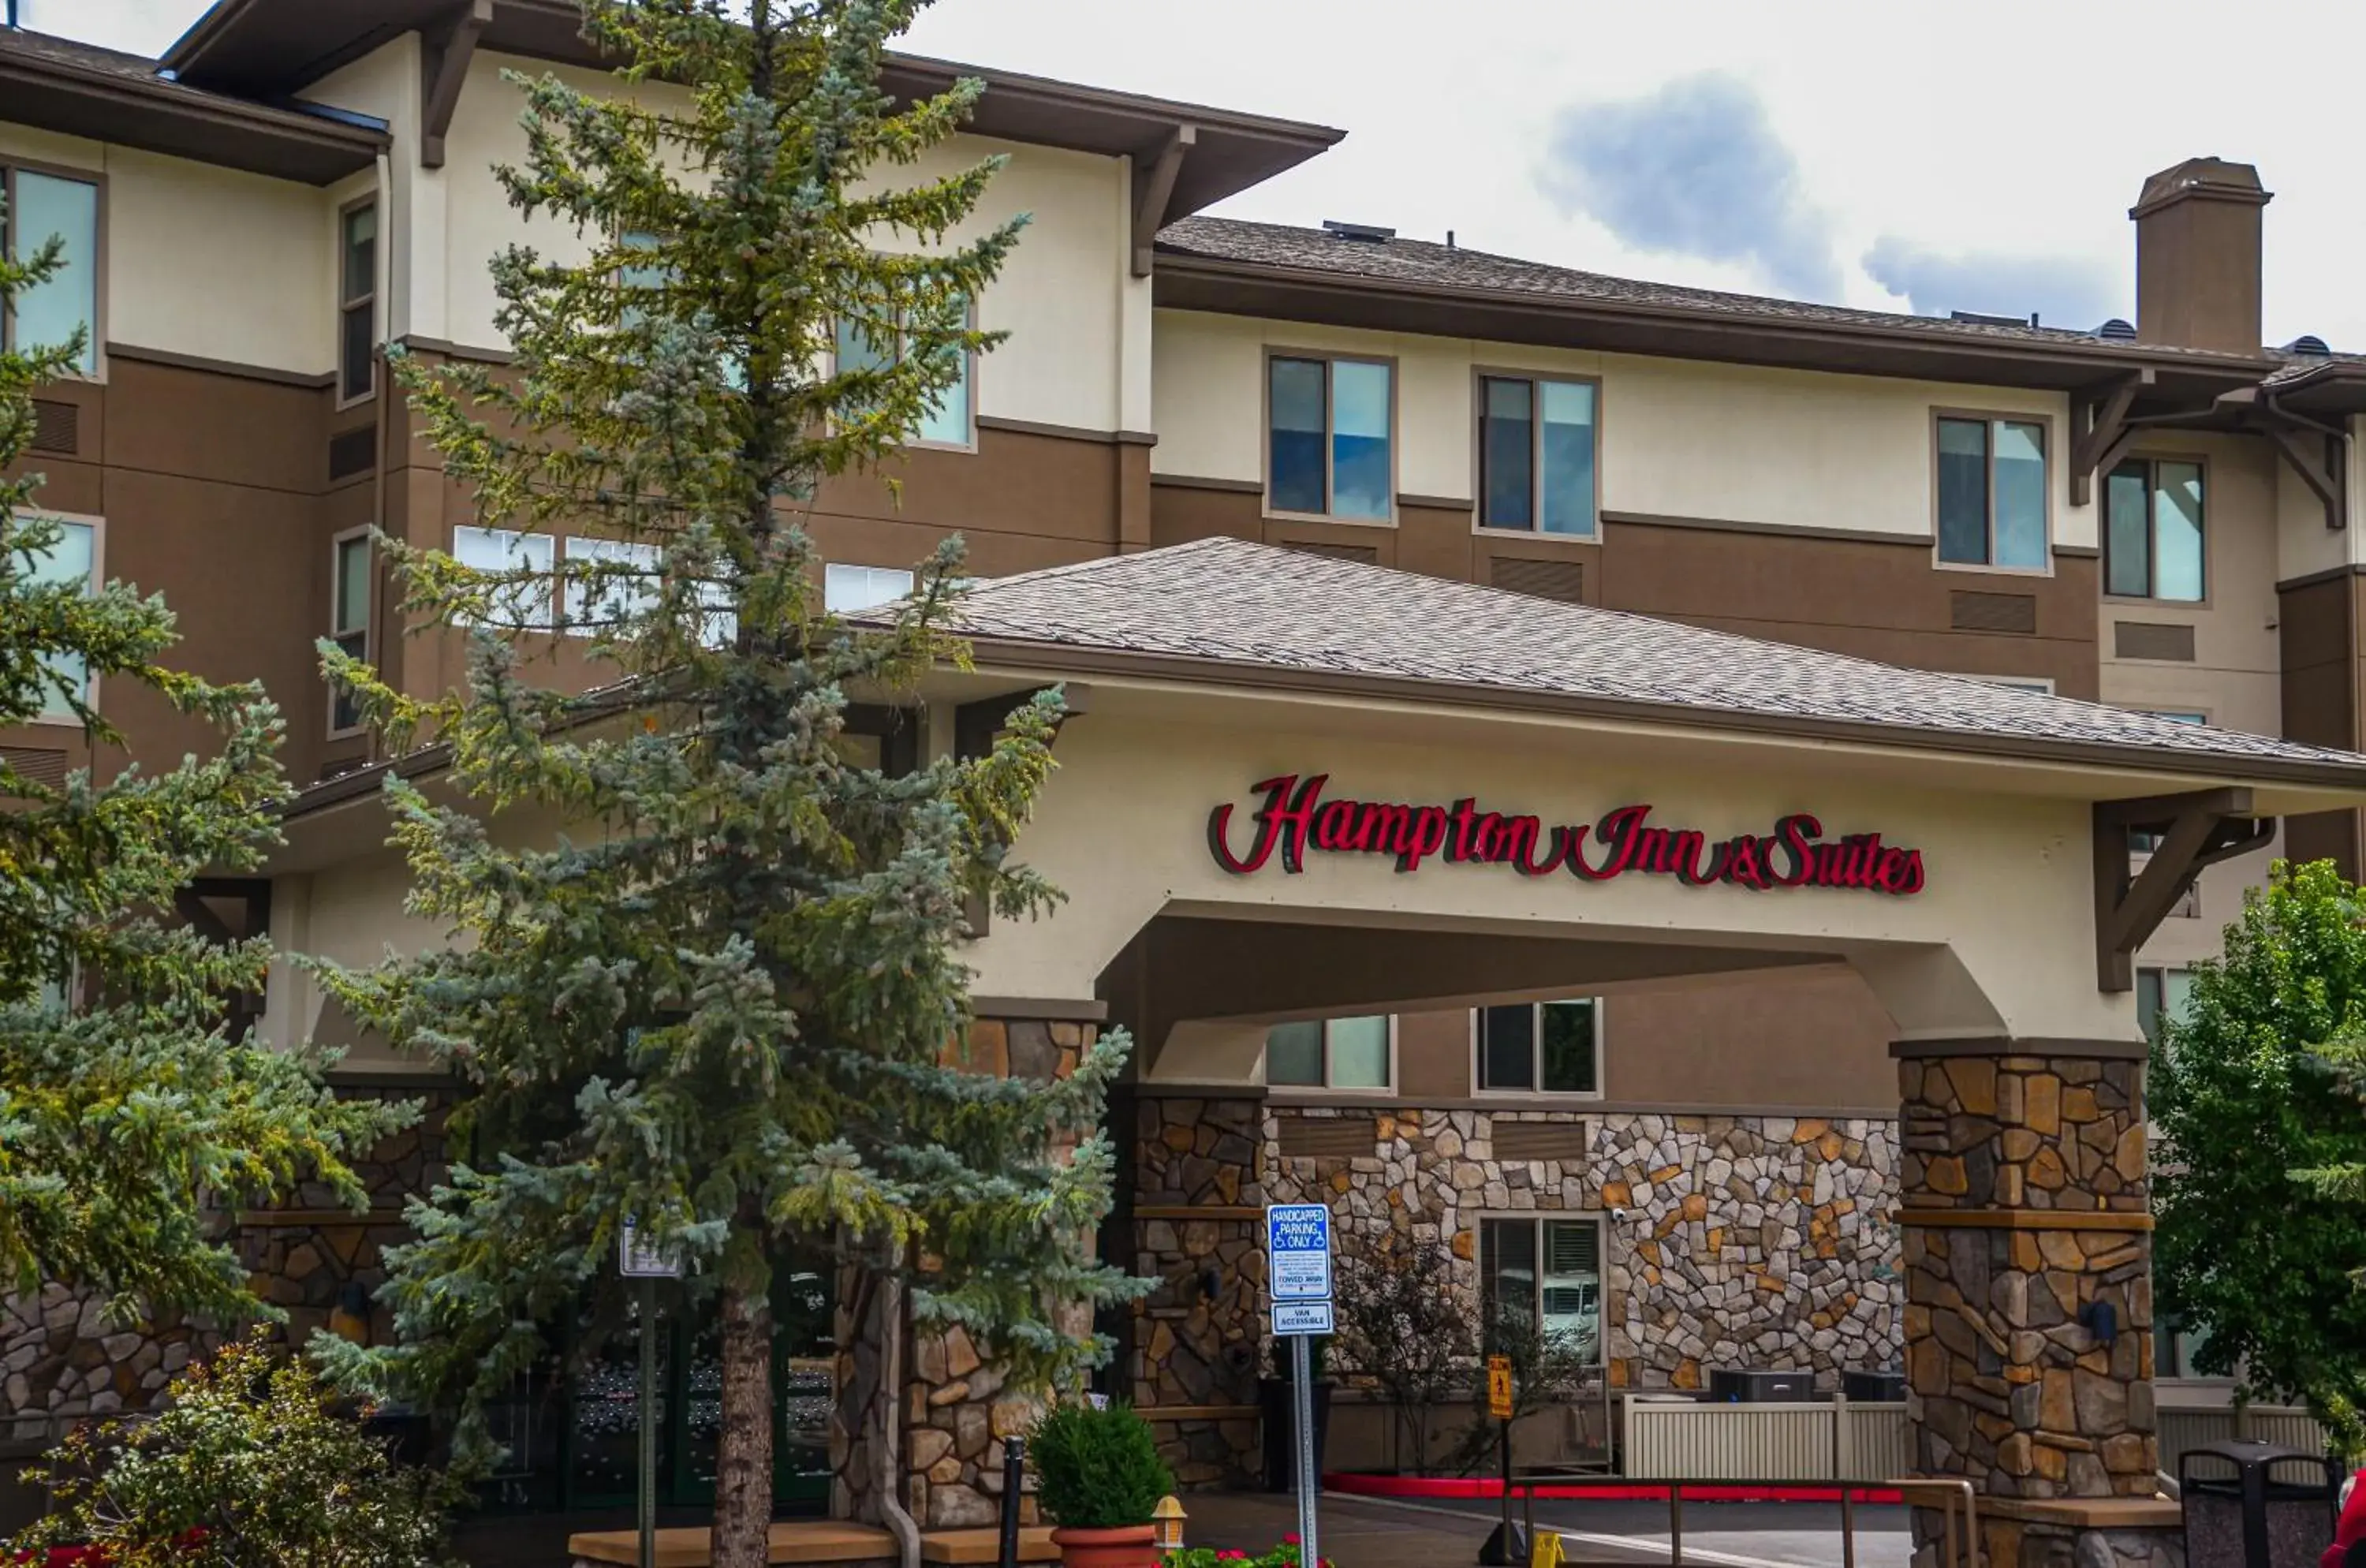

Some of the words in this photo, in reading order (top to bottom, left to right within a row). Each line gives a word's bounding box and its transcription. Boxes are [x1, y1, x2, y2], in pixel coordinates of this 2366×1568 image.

[1207, 774, 1569, 876] Hampton
[1566, 805, 1733, 882] Inn
[1723, 834, 1773, 890] &
[1760, 814, 1924, 894] Suites
[1272, 1210, 1324, 1222] HANDICAPPED
[1280, 1223, 1319, 1235] PARKING
[1288, 1235, 1311, 1249] ONLY
[1281, 1317, 1324, 1326] ACCESSIBLE
